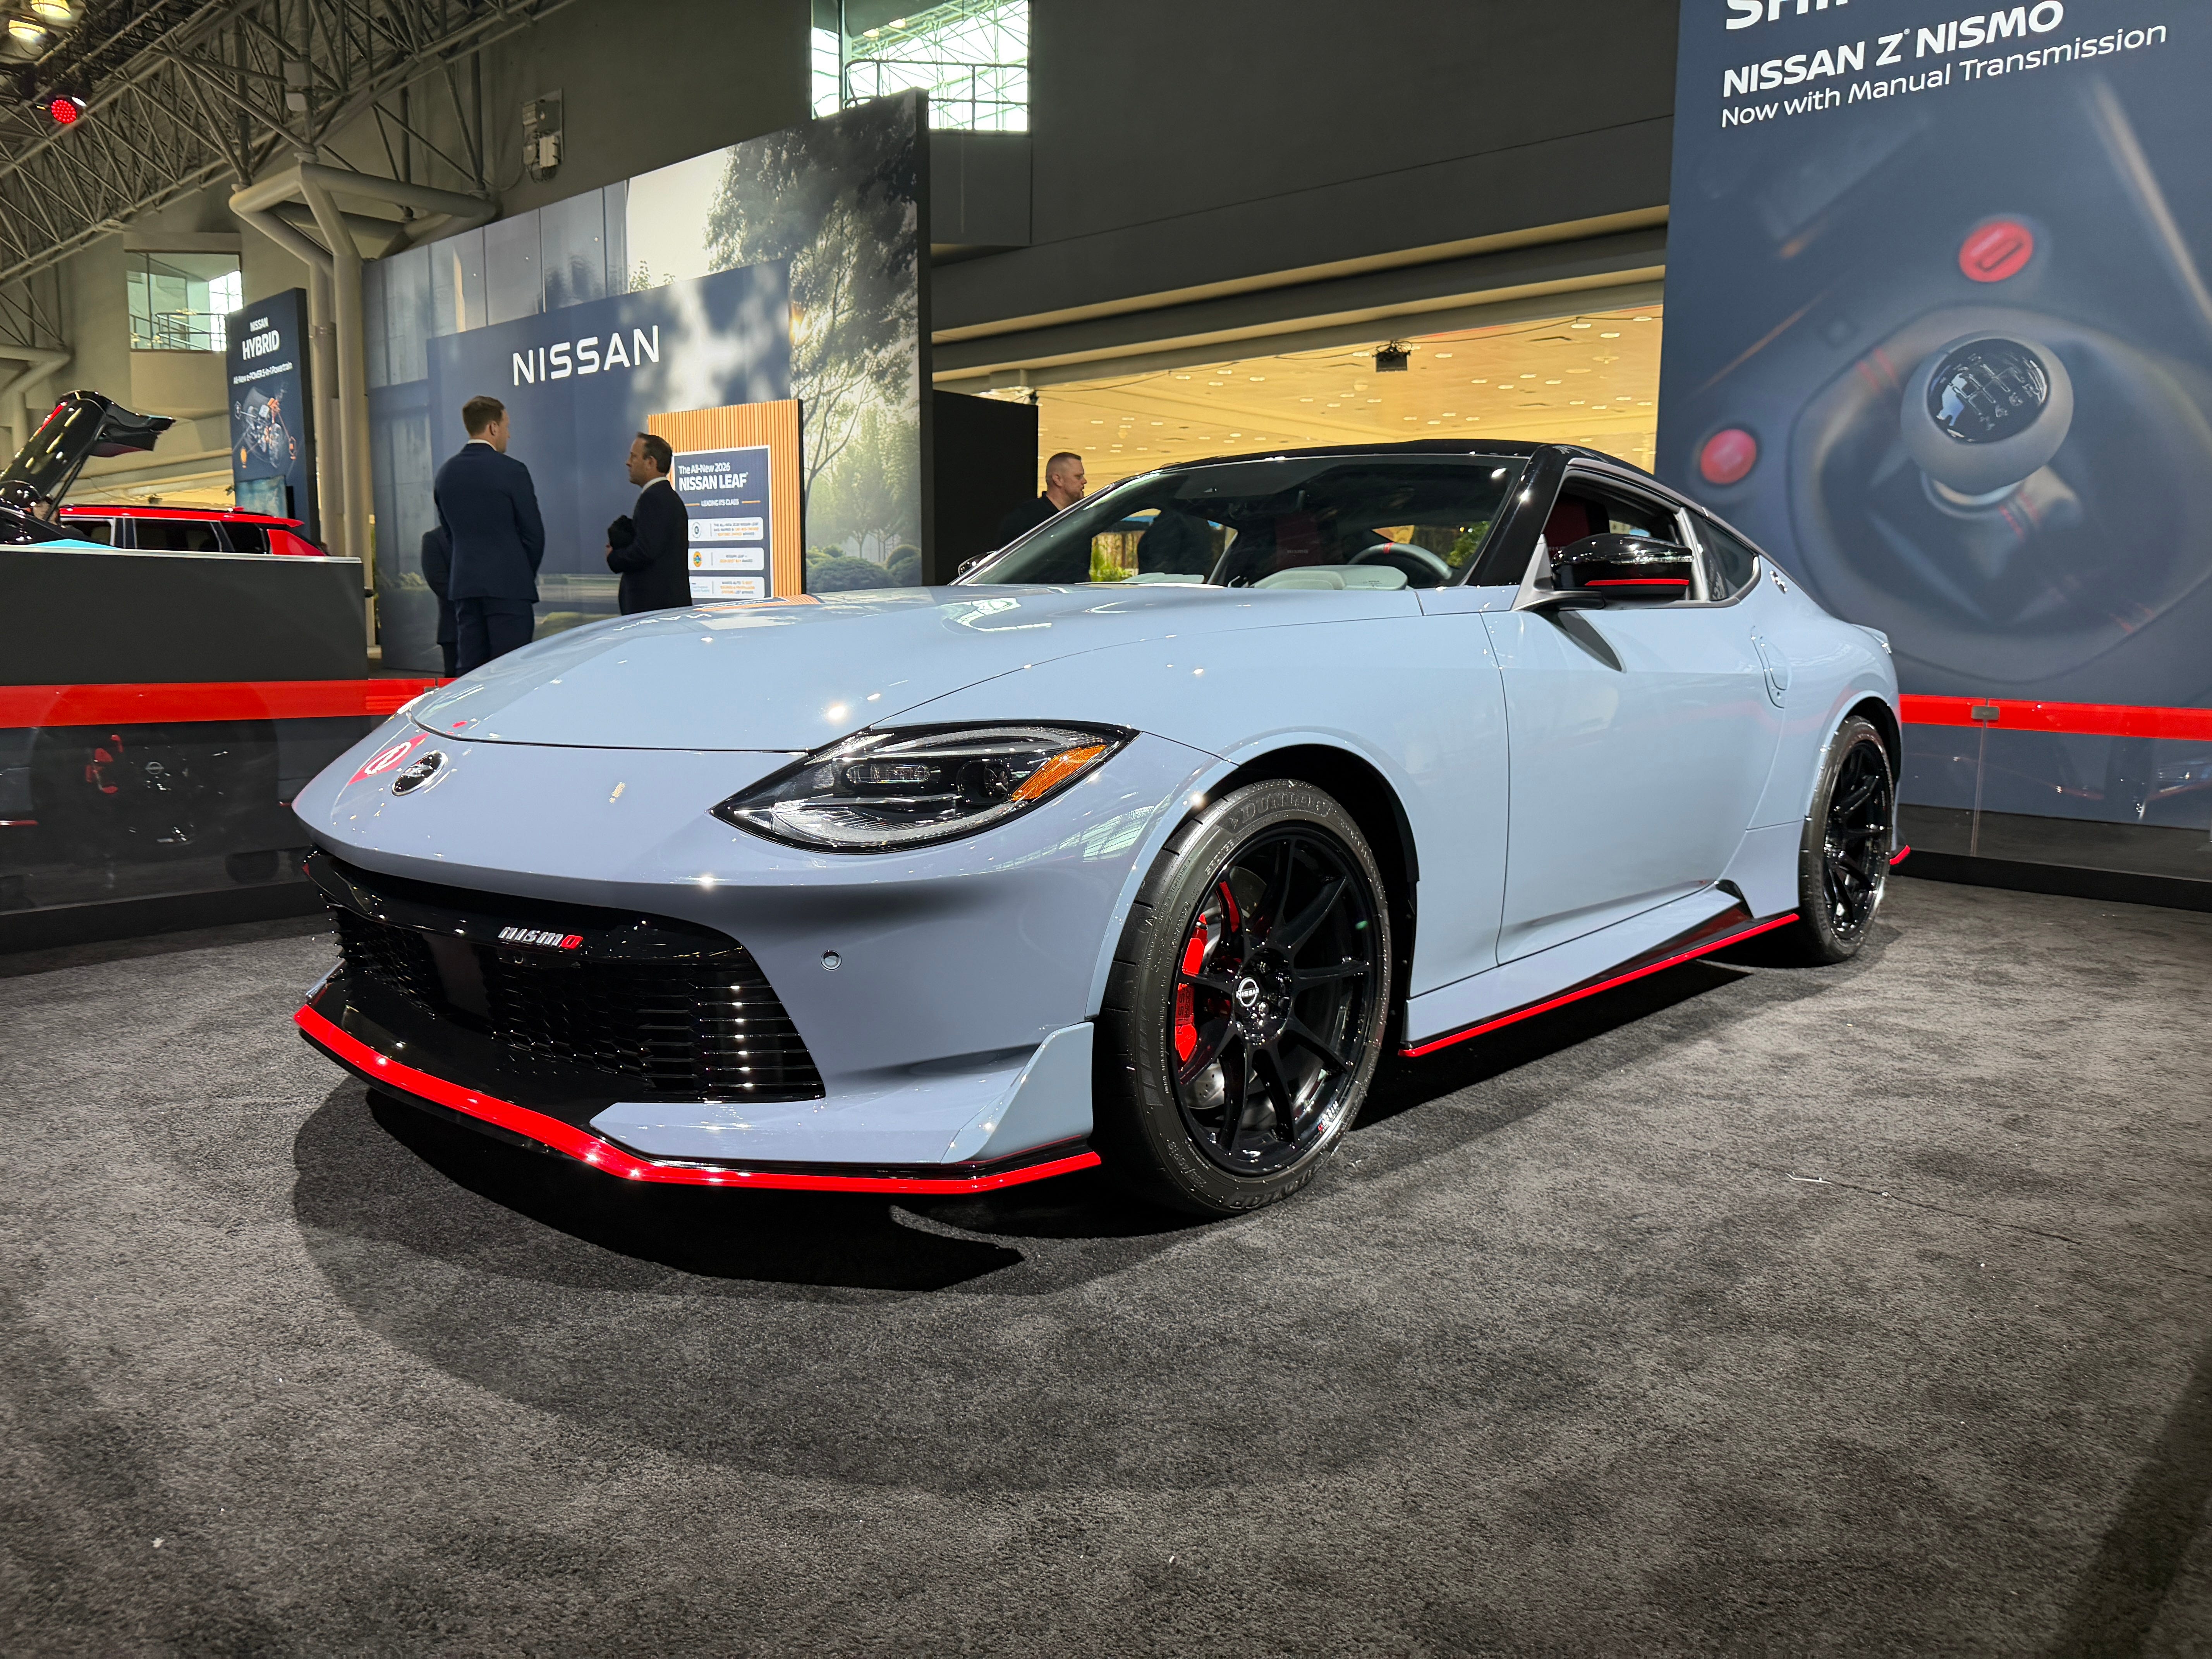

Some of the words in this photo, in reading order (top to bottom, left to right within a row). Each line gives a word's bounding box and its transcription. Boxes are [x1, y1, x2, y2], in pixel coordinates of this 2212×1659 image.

[1723, 41, 1865, 98] NISSAN
[1916, 0, 2064, 58] NISMO
[1722, 102, 1779, 128] Now
[1784, 87, 1841, 116] with
[1848, 63, 1951, 104] Manual
[1959, 25, 2167, 81] Transmission
[250, 316, 269, 332] NISSAN
[242, 330, 280, 361] HYBRID
[513, 325, 659, 386] NISSAN
[678, 465, 690, 474] The
[691, 464, 714, 474] All-New
[714, 462, 731, 472] 2026
[679, 475, 717, 491] NISSAN
[1236, 988, 1259, 998] NISSAN
